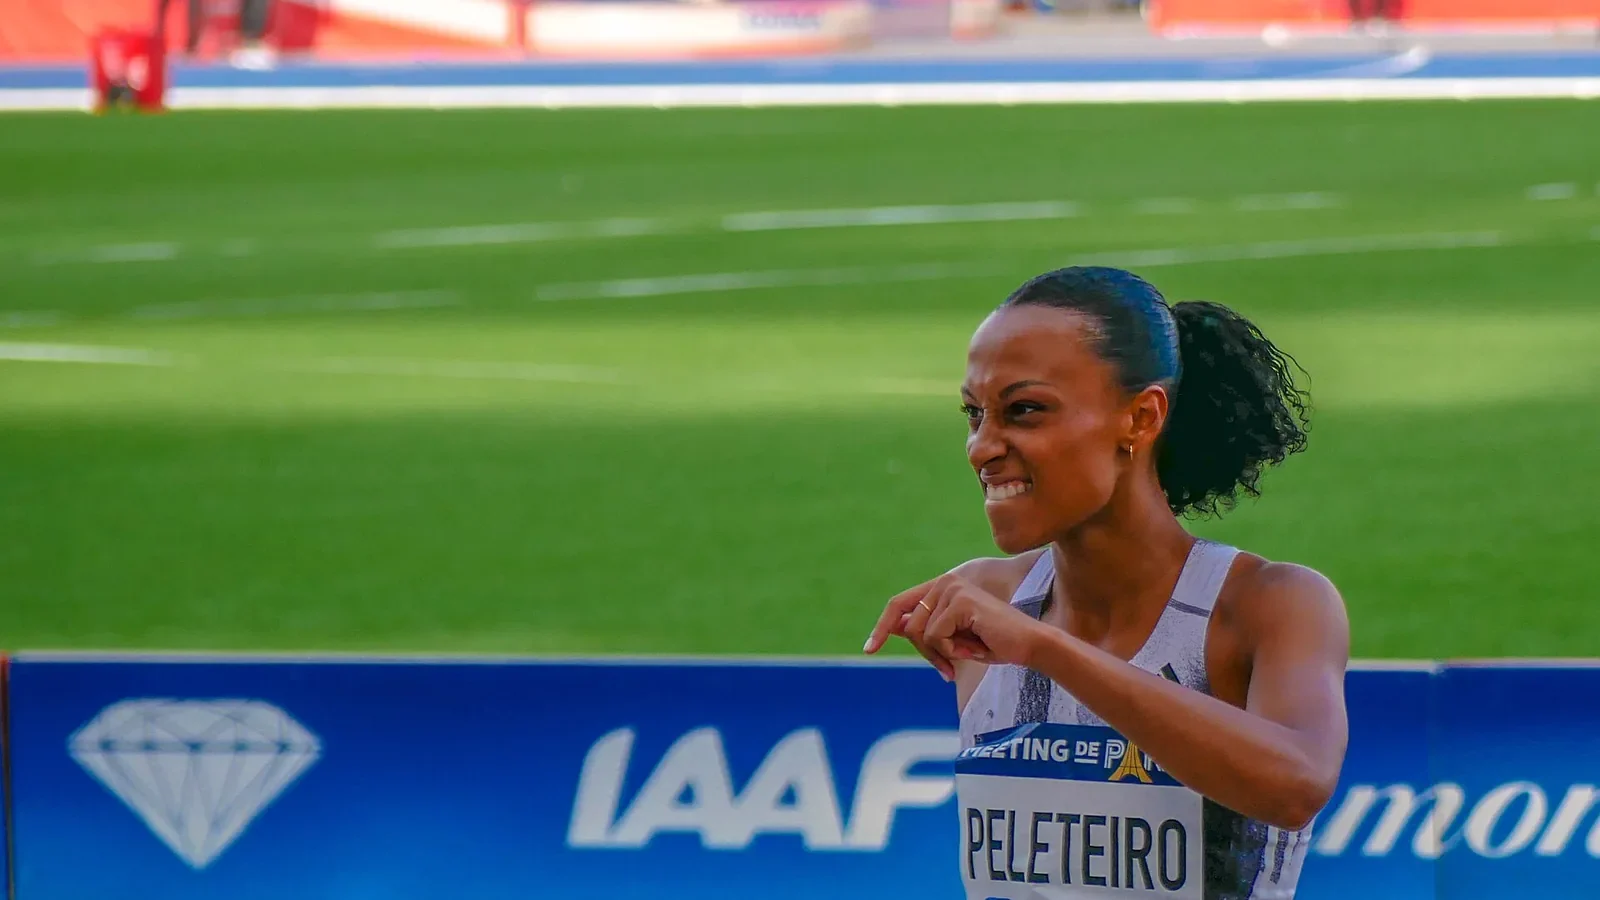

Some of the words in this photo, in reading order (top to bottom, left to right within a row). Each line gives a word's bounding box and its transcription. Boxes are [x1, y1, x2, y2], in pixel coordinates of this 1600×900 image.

[567, 726, 958, 851] IAAF
[961, 738, 1069, 762] MEETING
[1074, 741, 1101, 759] DE
[966, 808, 1187, 891] PELETEIRO
